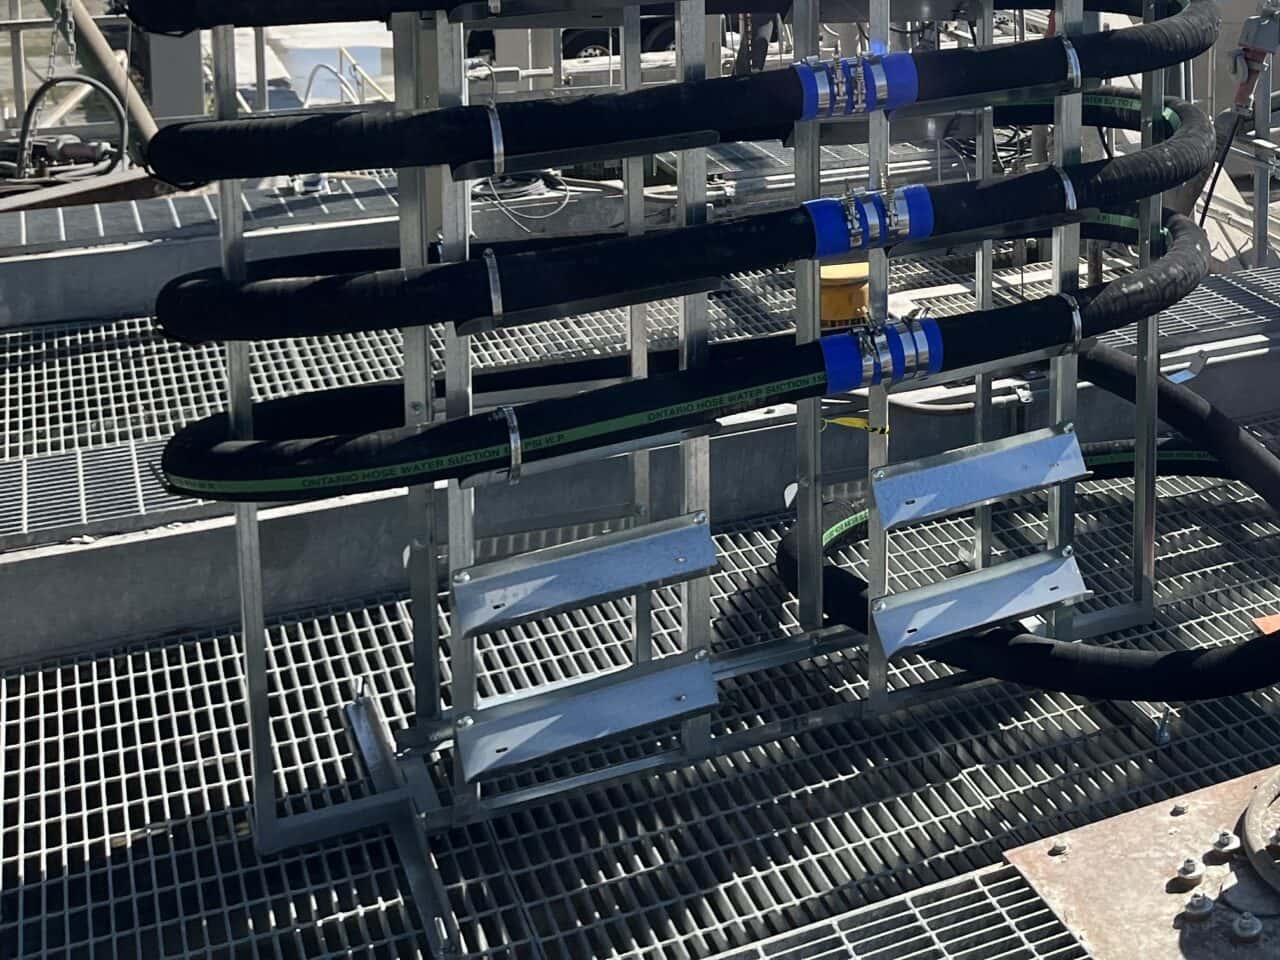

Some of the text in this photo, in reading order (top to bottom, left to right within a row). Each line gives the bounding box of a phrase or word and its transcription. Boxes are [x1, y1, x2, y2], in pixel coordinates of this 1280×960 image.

[648, 403, 694, 421] ONTARIO
[696, 398, 725, 411] HOSE
[727, 389, 763, 404] WATER
[766, 379, 811, 396] SUCTION
[302, 471, 359, 488] ONTARIO
[361, 466, 397, 480] HOSE
[400, 458, 445, 475] WATER
[447, 448, 502, 465] SUCTION
